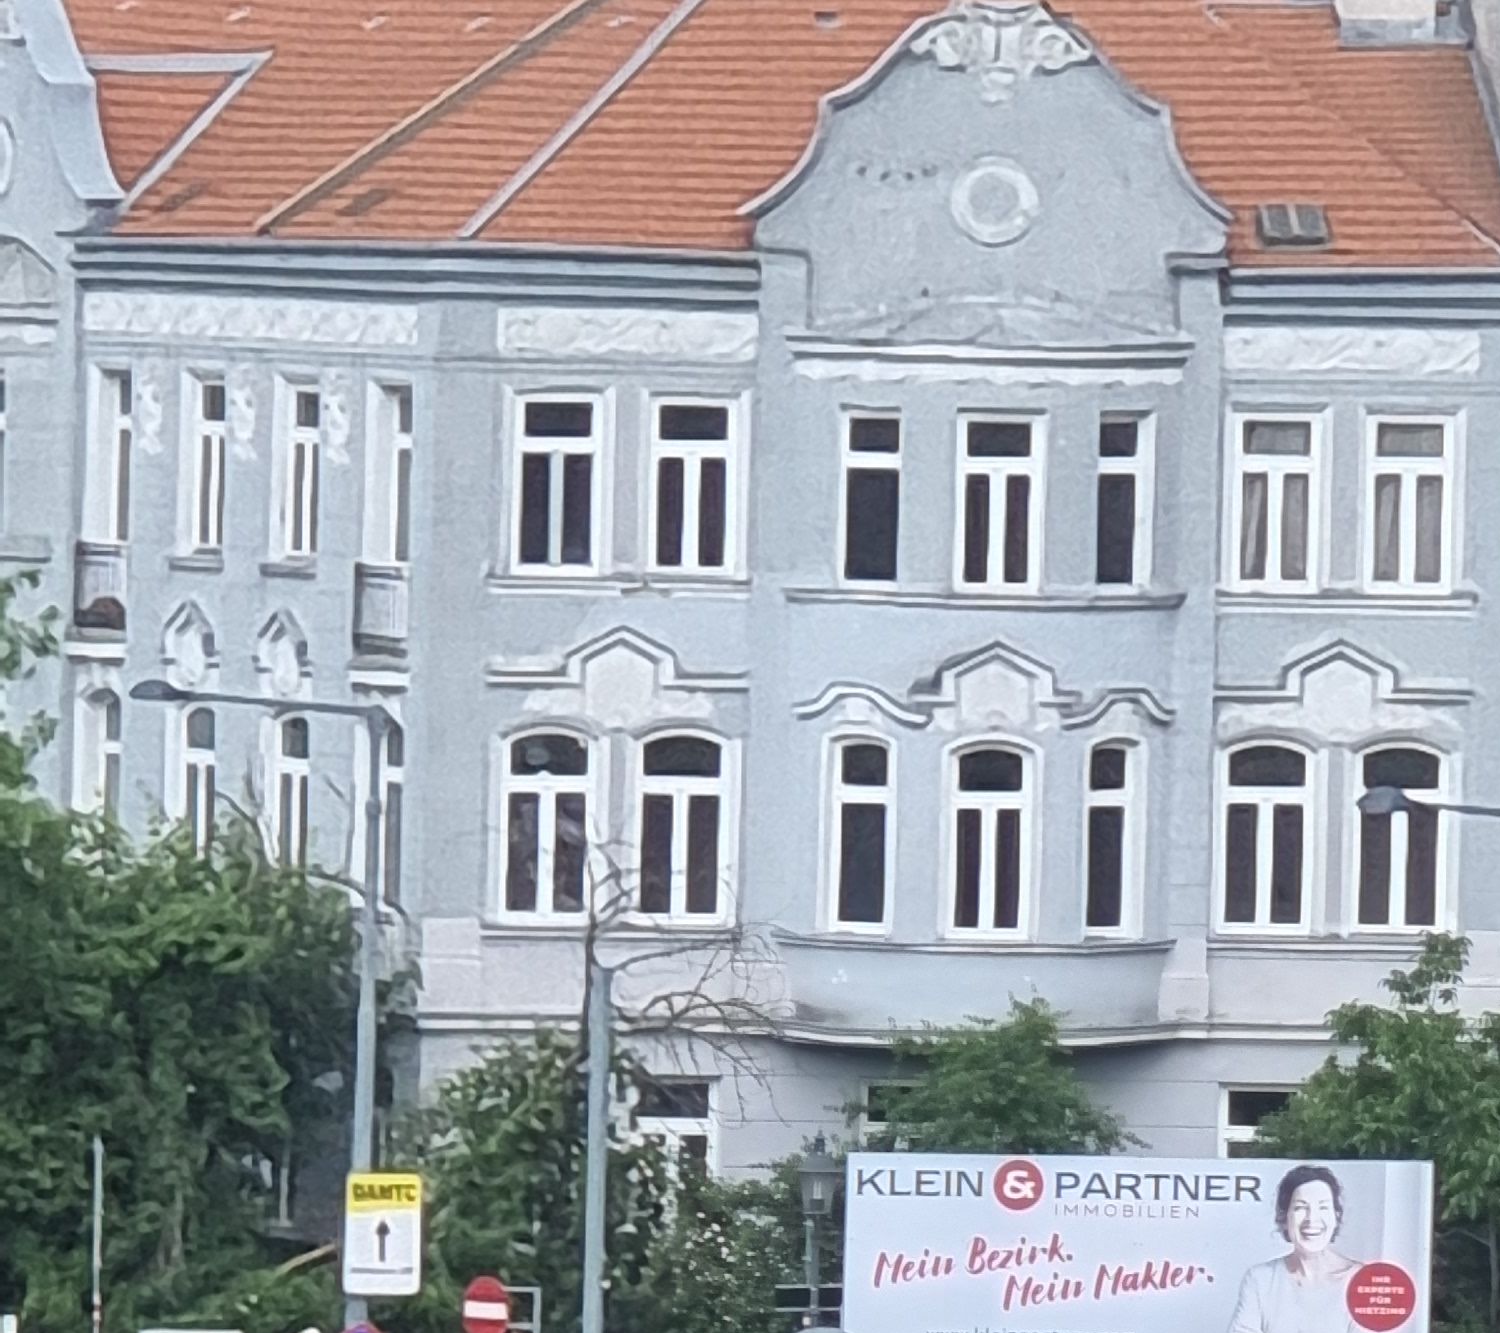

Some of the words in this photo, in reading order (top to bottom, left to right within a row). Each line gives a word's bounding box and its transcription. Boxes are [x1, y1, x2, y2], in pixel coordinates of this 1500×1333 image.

[856, 1168, 984, 1197] KLEIN
[1002, 1169, 1036, 1200] &
[1055, 1171, 1263, 1202] PARTNER
[1055, 1203, 1200, 1218] IMMOBILIEN
[873, 1248, 955, 1288] Mein
[966, 1233, 1074, 1275] Bezirk.
[1002, 1272, 1085, 1312] Mein
[1094, 1260, 1214, 1300] Makler.
